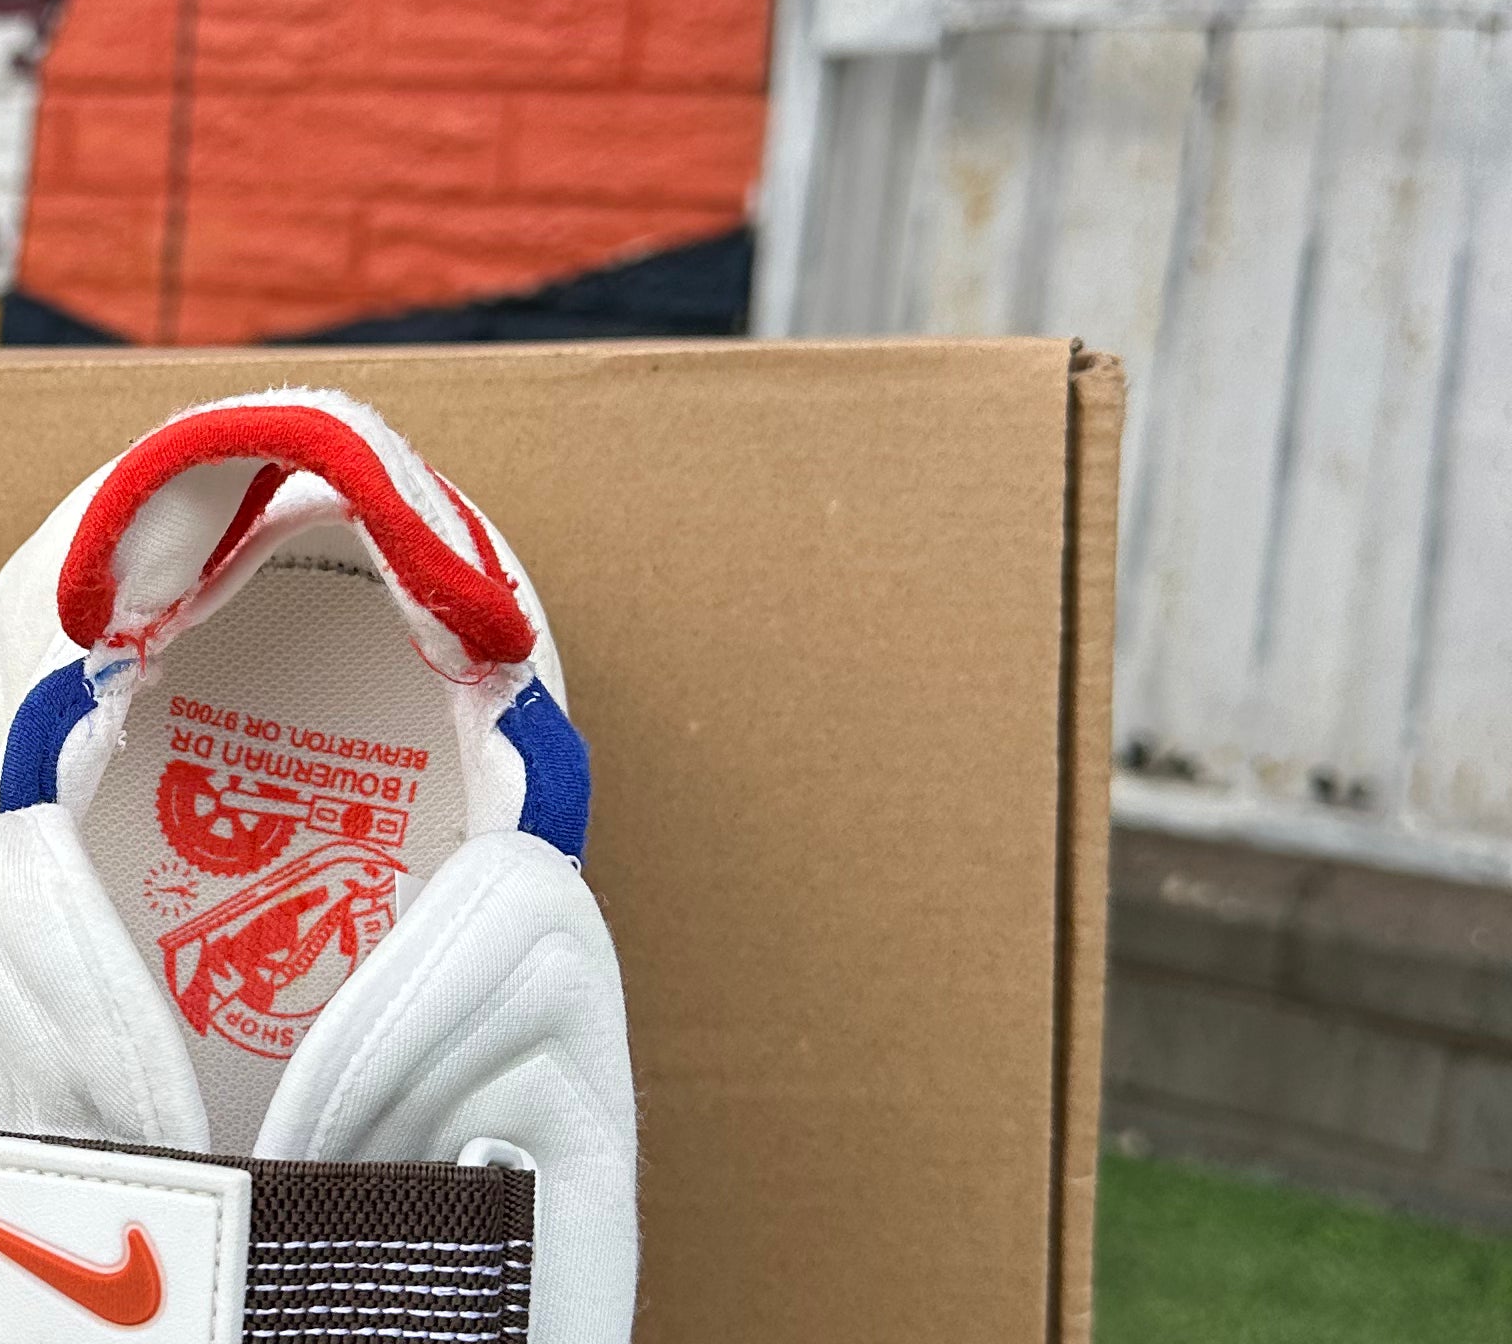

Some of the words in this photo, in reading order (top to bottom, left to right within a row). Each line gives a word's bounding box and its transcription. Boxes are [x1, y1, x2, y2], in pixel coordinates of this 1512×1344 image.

[243, 714, 281, 742] OR
[222, 741, 402, 802] BOWERMAN
[225, 1011, 294, 1047] SHOP
